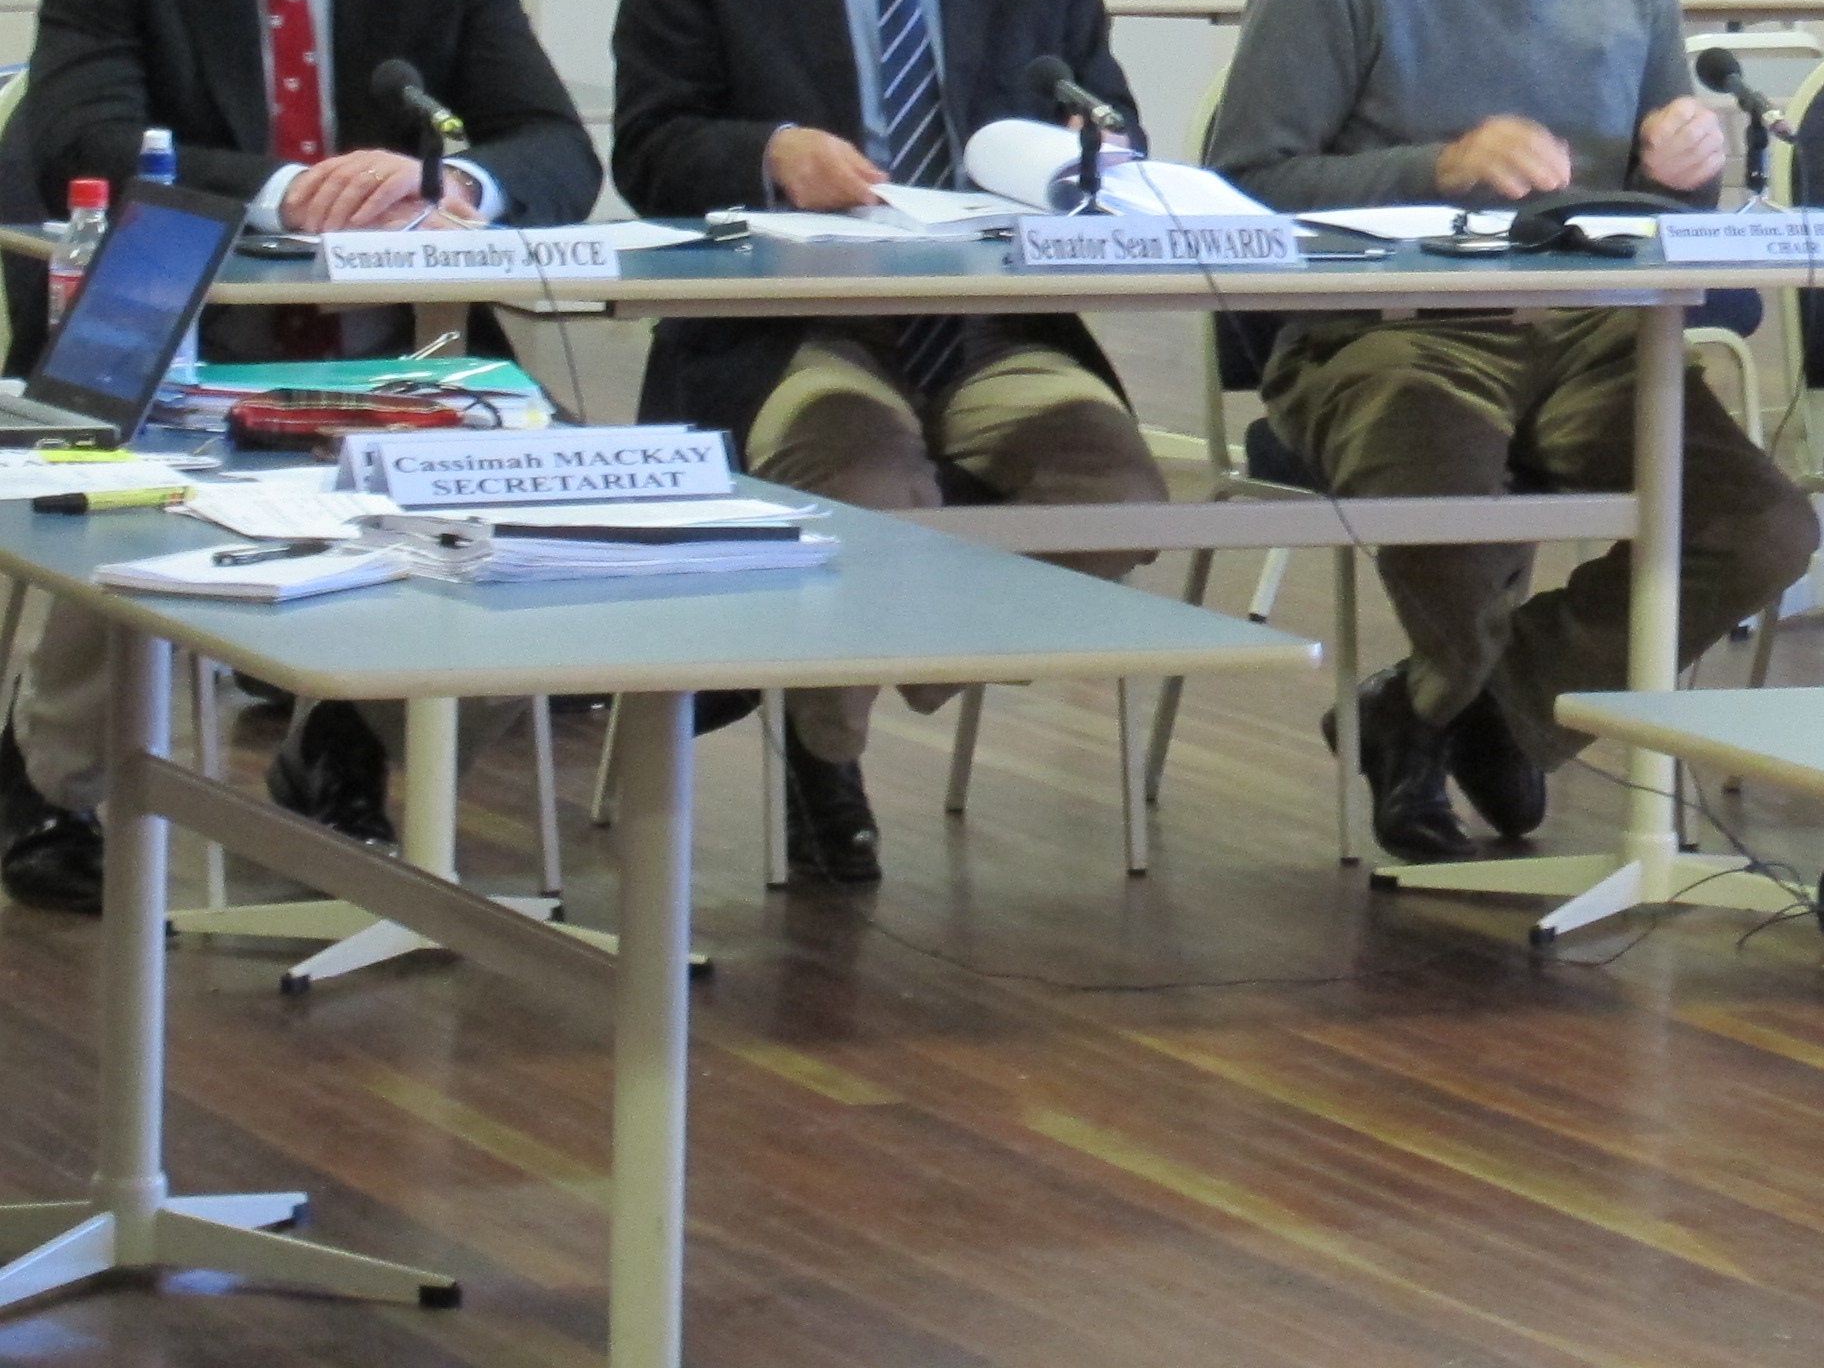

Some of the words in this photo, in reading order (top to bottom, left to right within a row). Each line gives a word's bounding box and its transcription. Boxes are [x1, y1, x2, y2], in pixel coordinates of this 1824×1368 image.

[1026, 229, 1107, 260] Senator
[1111, 229, 1164, 259] Sean
[1167, 228, 1288, 260] EDWARDS
[1666, 225, 1721, 238] Senator
[1723, 224, 1746, 237] the
[330, 246, 416, 270] Senator
[421, 243, 516, 274] Barnaby
[522, 240, 607, 268] JOYCE
[393, 452, 546, 474] Cassimah
[551, 446, 713, 470] MACKAY
[431, 469, 686, 497] SECRETARIAT
